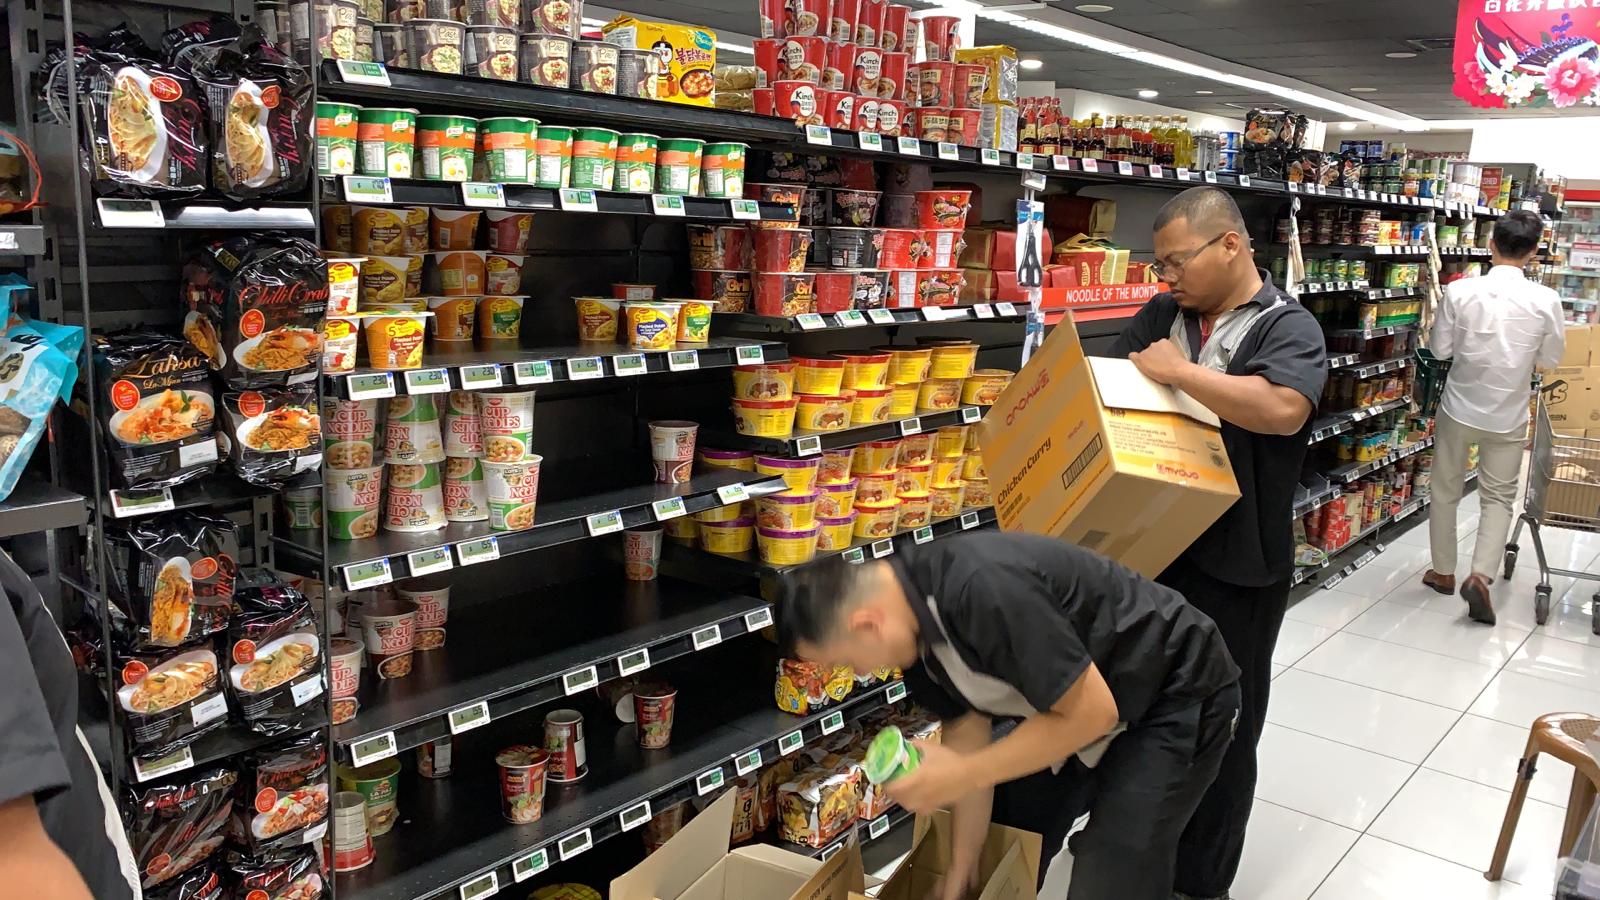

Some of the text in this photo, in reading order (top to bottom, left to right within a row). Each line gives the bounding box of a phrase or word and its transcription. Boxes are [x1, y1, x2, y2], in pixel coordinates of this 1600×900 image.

[1066, 285, 1158, 303] NOODLE OF THE MONTH
[997, 461, 1028, 505] Chicken
[1026, 437, 1051, 470] Curry
